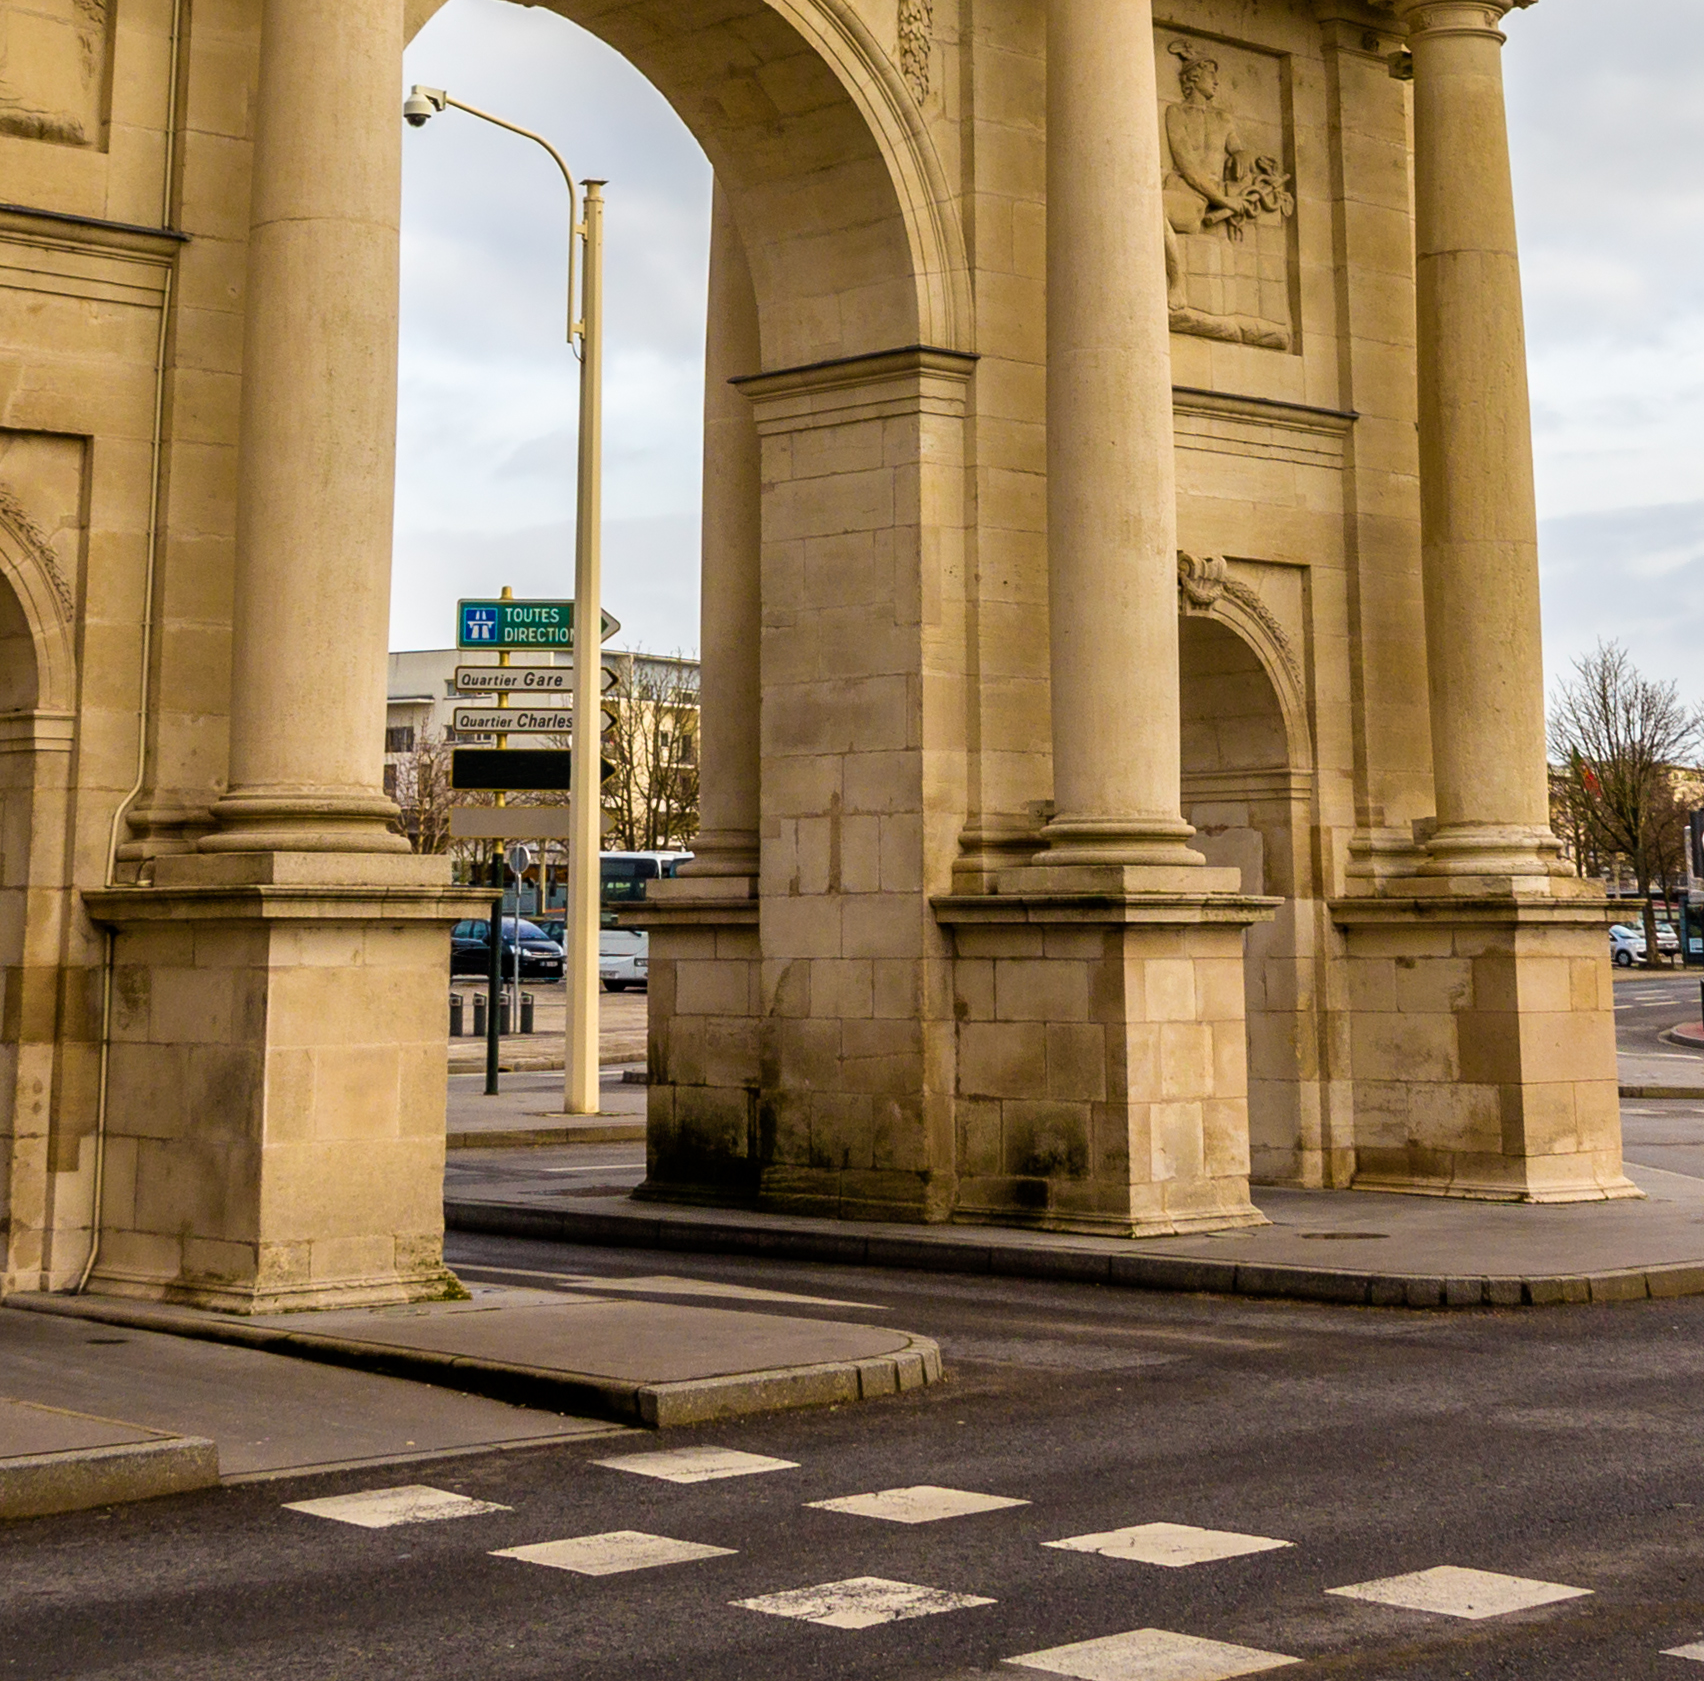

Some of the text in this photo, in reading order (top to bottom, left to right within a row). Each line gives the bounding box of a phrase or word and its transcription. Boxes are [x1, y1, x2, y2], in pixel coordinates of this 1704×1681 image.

[505, 608, 560, 623] TOUTES
[504, 627, 575, 643] DIRECTION
[461, 671, 564, 687] Quartier Gare
[460, 713, 573, 728] Quartier Charles
